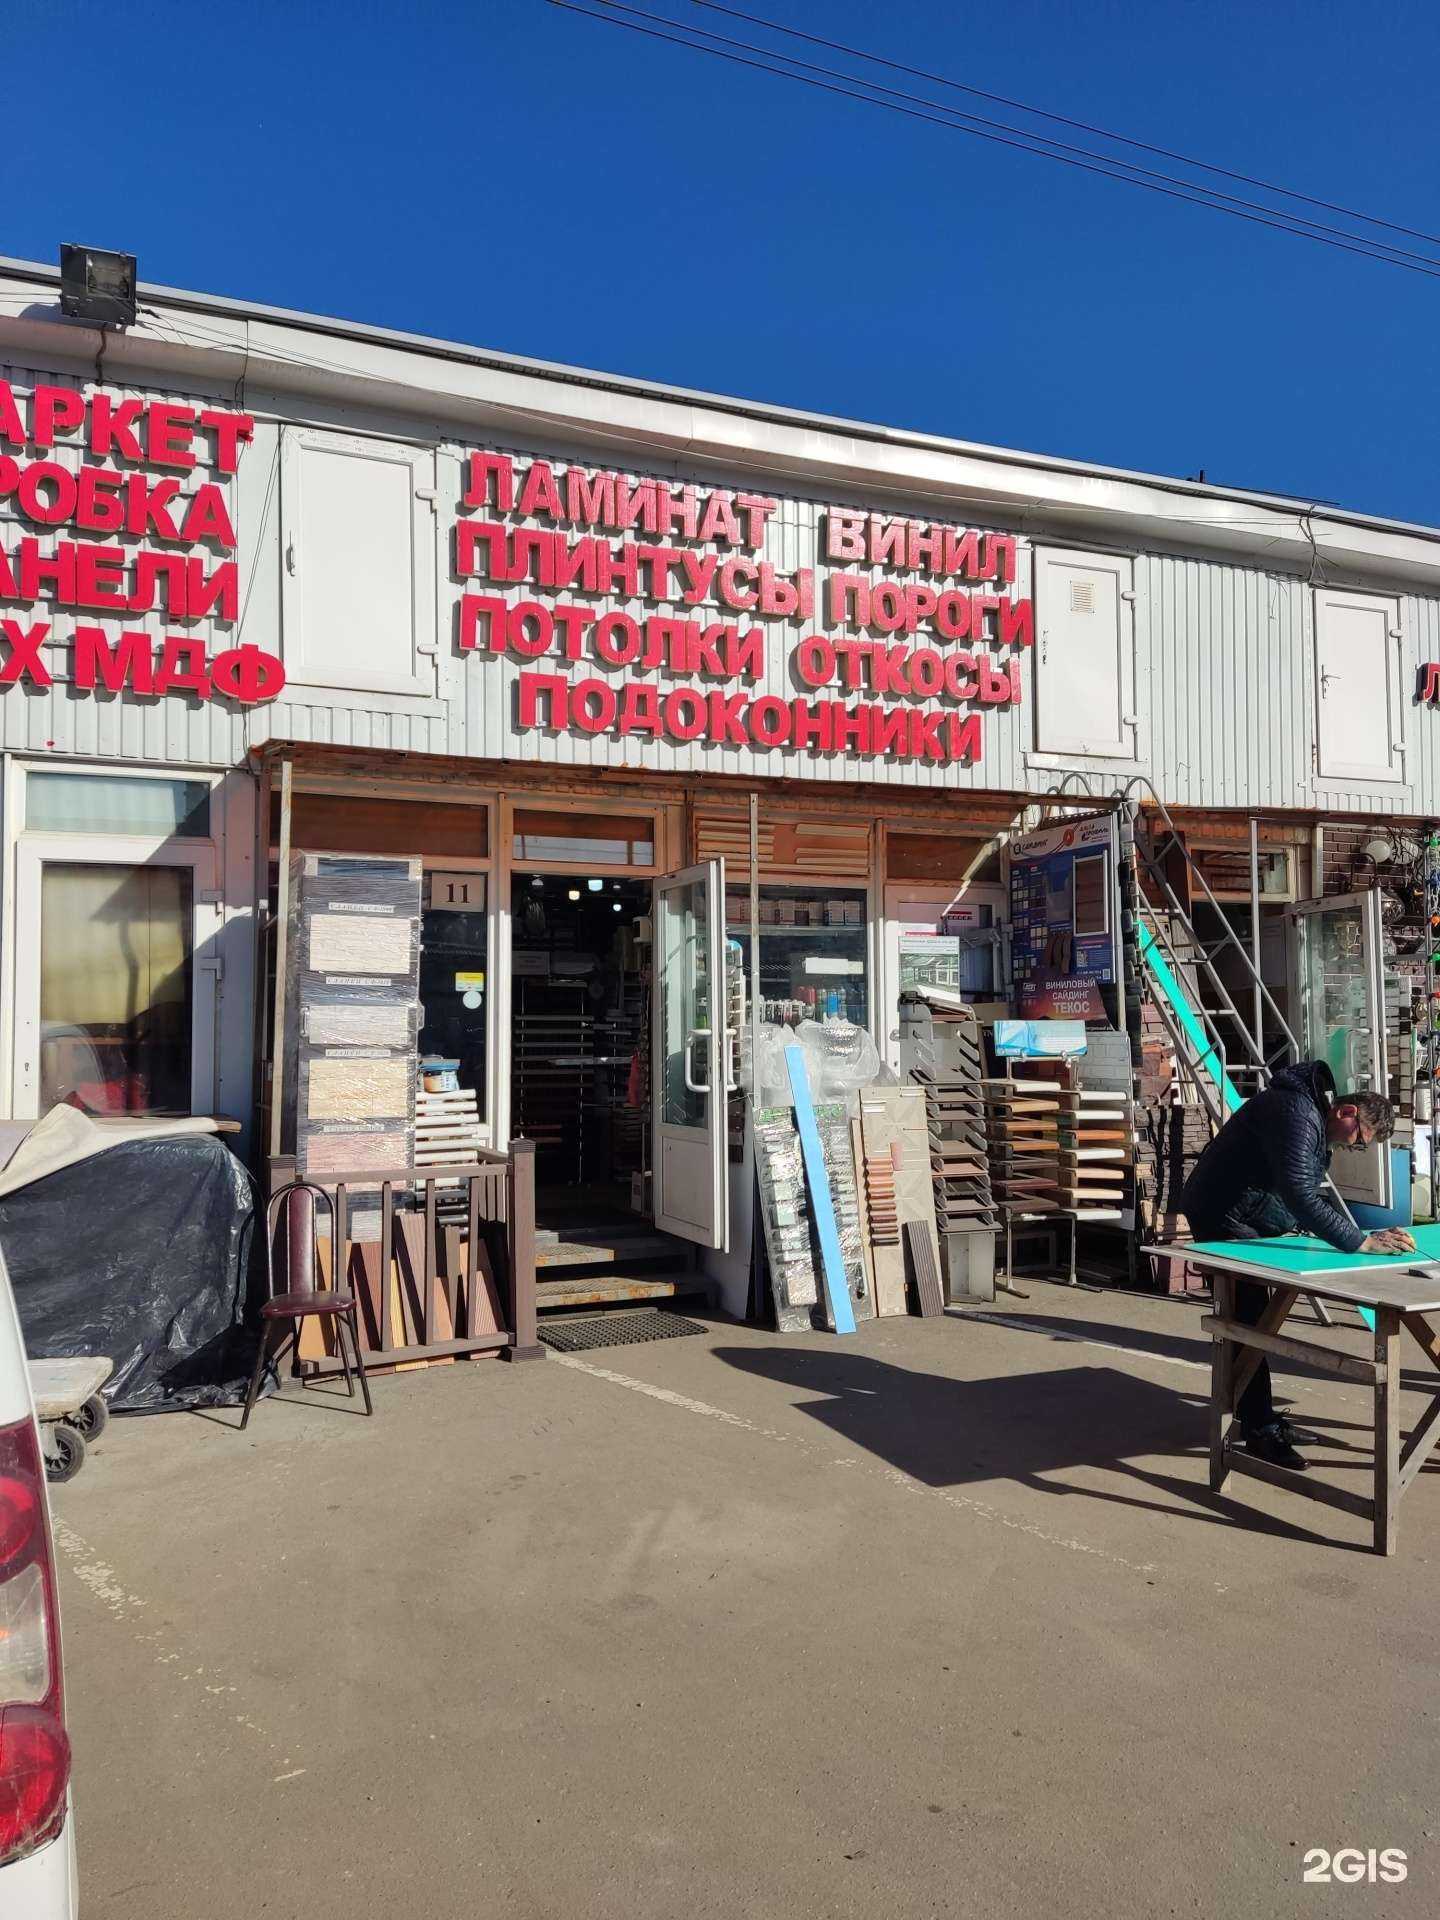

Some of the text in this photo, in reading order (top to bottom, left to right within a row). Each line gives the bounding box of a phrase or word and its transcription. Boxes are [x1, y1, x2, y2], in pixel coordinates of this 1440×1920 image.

[464, 450, 1017, 584] ЛАМИНАТ ВИНИЛ
[456, 518, 1033, 647] ПЛИНТУСЫ ПОРОГИ
[75, 626, 286, 705] МДФ
[459, 593, 1021, 705] ПОТОЛКИ ОТКОСЫ
[519, 671, 982, 763] ПОДОКОННИКИ
[445, 882, 471, 904] 11
[1045, 977, 1096, 990] ВИНИЛОВЫЙ
[1052, 990, 1089, 1001] САЙДИНГ
[1052, 1001, 1090, 1014] ТЕКОС
